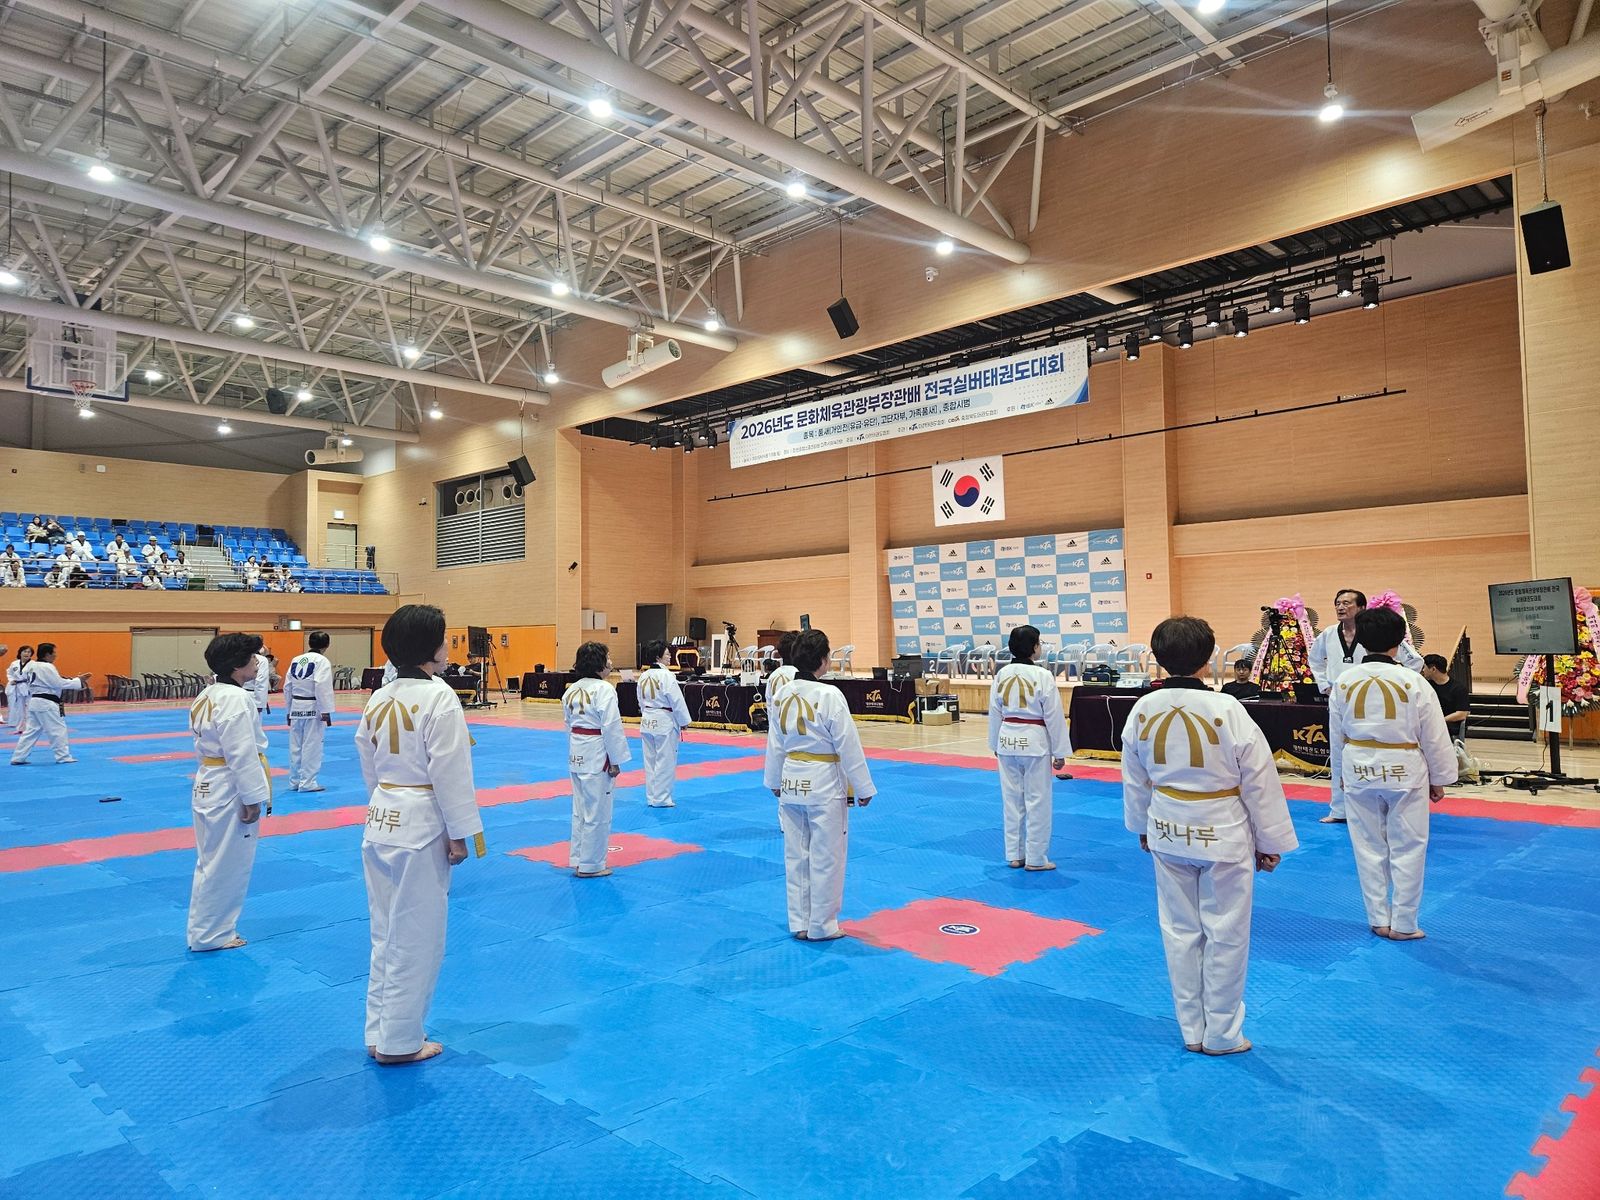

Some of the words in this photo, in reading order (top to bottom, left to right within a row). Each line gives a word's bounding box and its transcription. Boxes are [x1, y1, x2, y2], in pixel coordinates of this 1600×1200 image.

[741, 414, 794, 440] 2026년도
[797, 385, 921, 428] 문화체육관광부장관배
[924, 352, 1065, 401] 전국실버태권도대회
[929, 660, 935, 672] 2
[705, 696, 720, 709] KTA
[866, 689, 882, 702] KTA
[1546, 700, 1554, 722] 1
[1292, 724, 1328, 744] KTA
[1000, 736, 1030, 751] 벗나루
[1353, 765, 1409, 782] 벗나루
[1154, 818, 1219, 848] 벗나루
